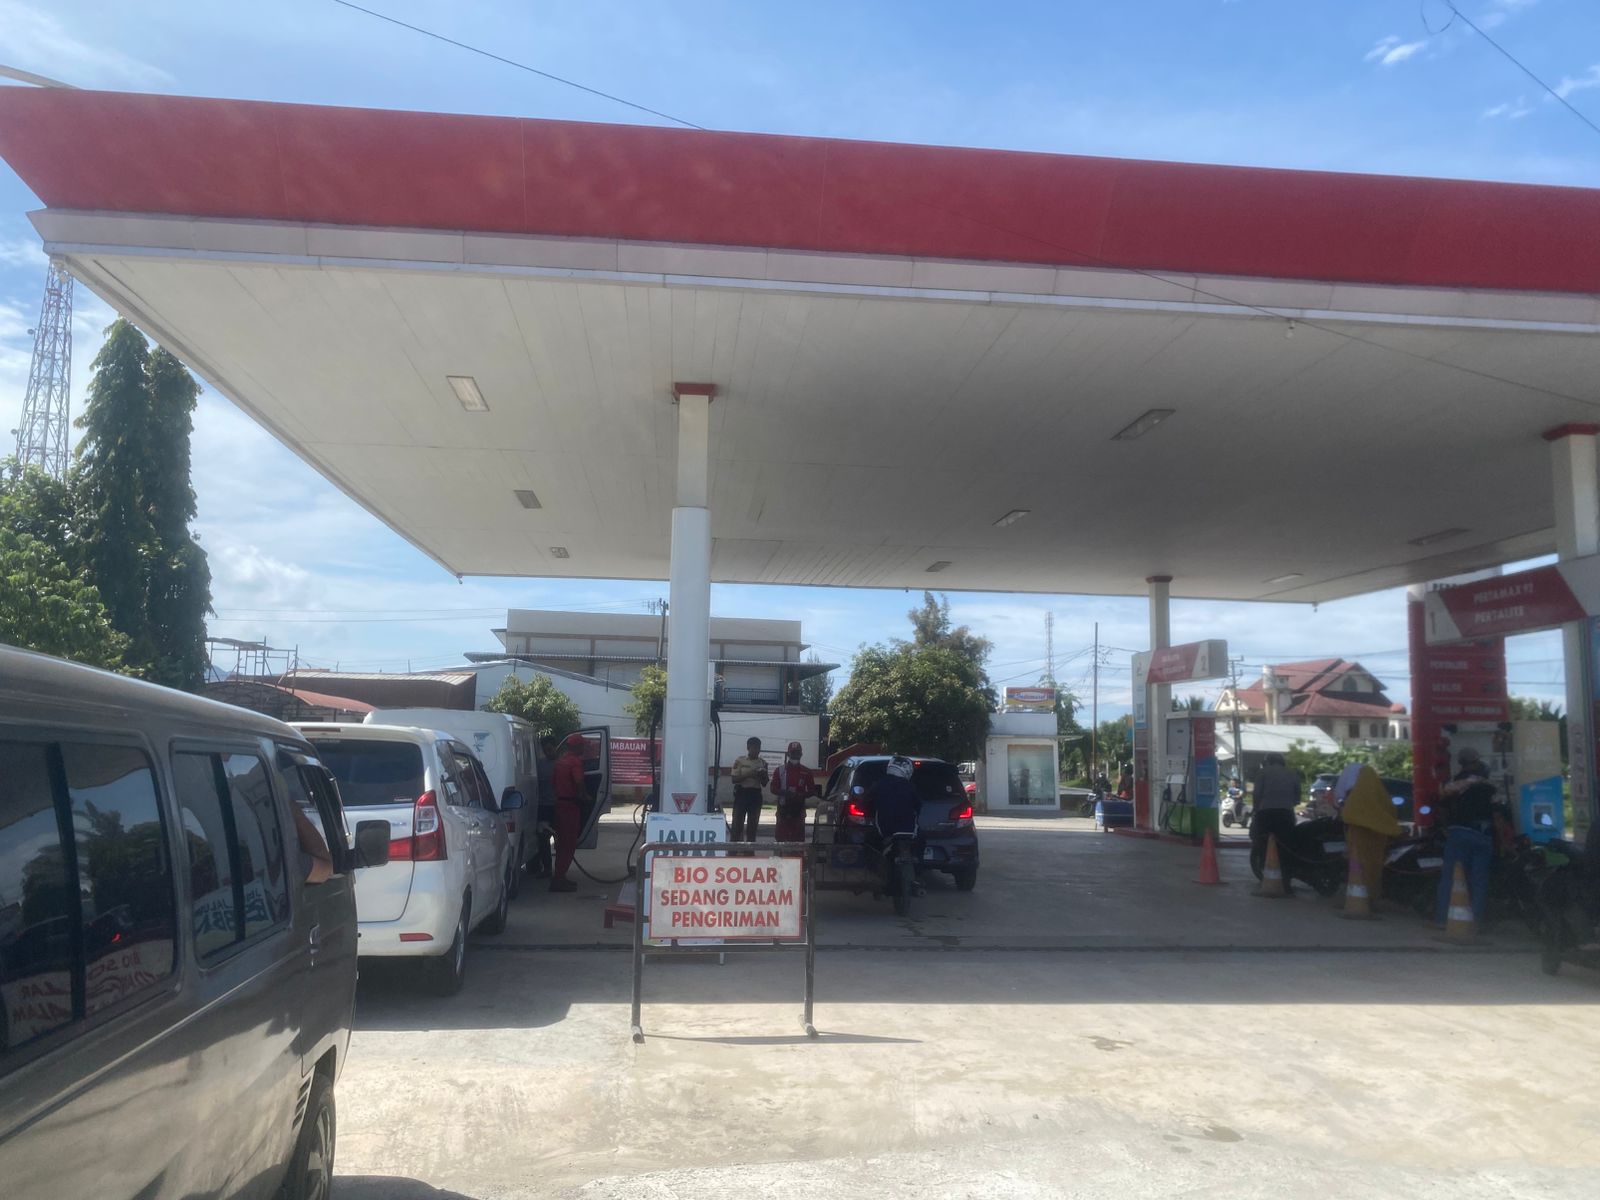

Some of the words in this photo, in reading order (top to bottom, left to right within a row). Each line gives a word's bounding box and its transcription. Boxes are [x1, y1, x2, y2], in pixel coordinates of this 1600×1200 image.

[674, 866, 709, 884] BIO
[714, 866, 778, 884] SOLAR
[661, 889, 730, 906] SEDANG
[735, 889, 793, 906] DALAM
[671, 911, 780, 928] PENGIRIMAN
